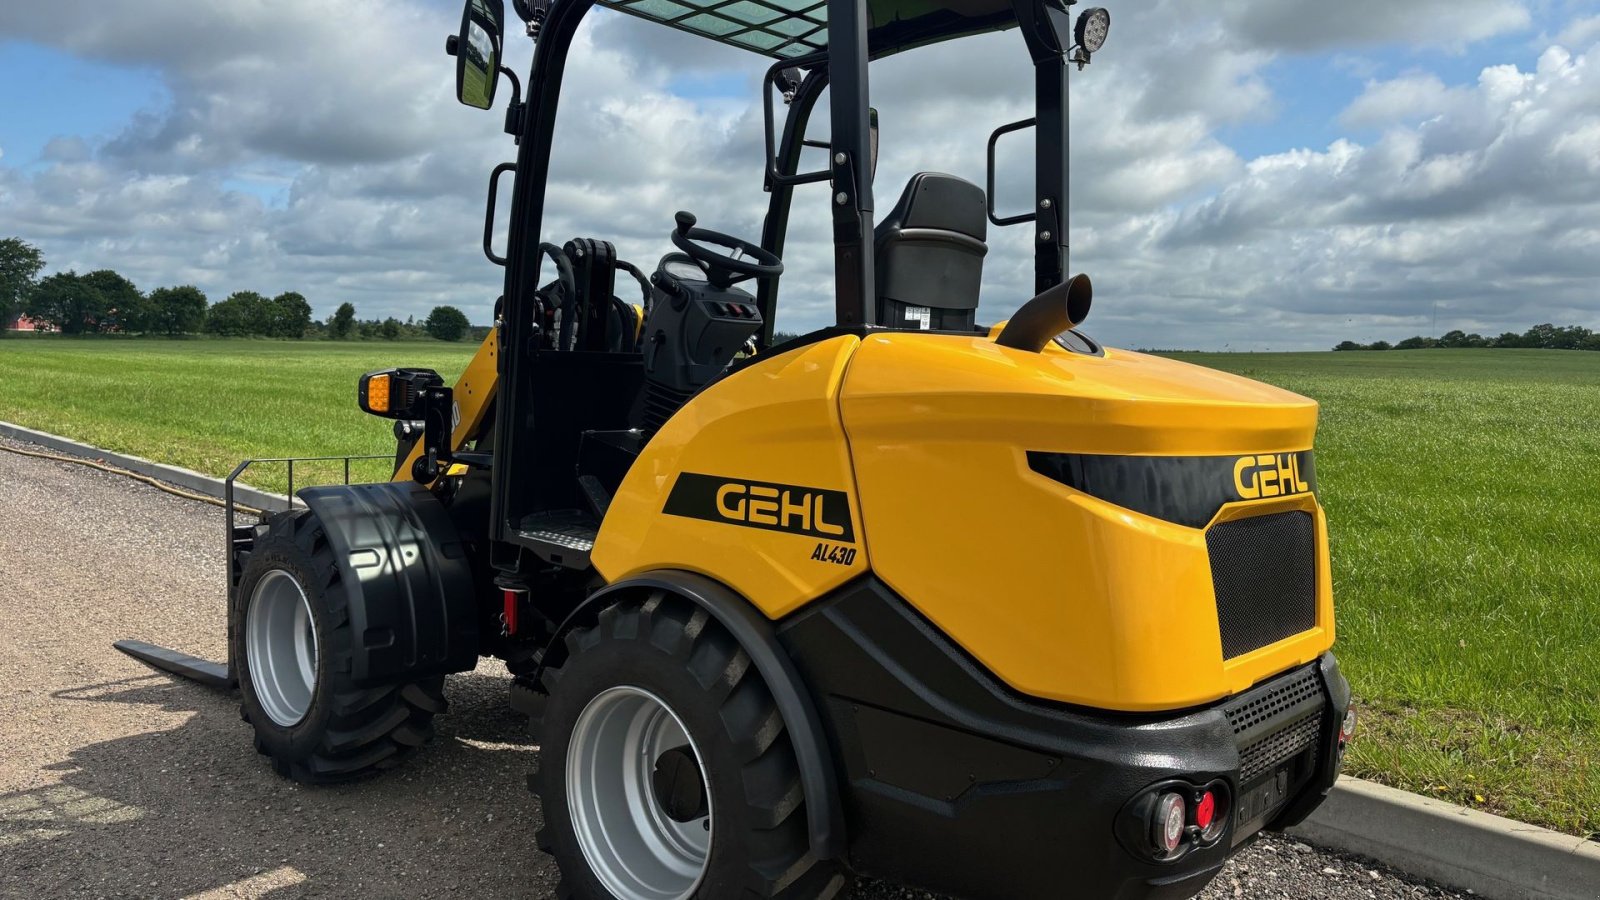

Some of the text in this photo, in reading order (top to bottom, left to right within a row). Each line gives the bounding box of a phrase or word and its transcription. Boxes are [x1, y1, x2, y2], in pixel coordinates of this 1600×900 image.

[1233, 453, 1308, 499] GEHL
[716, 483, 844, 535] GEHL
[811, 543, 857, 566] AL430
